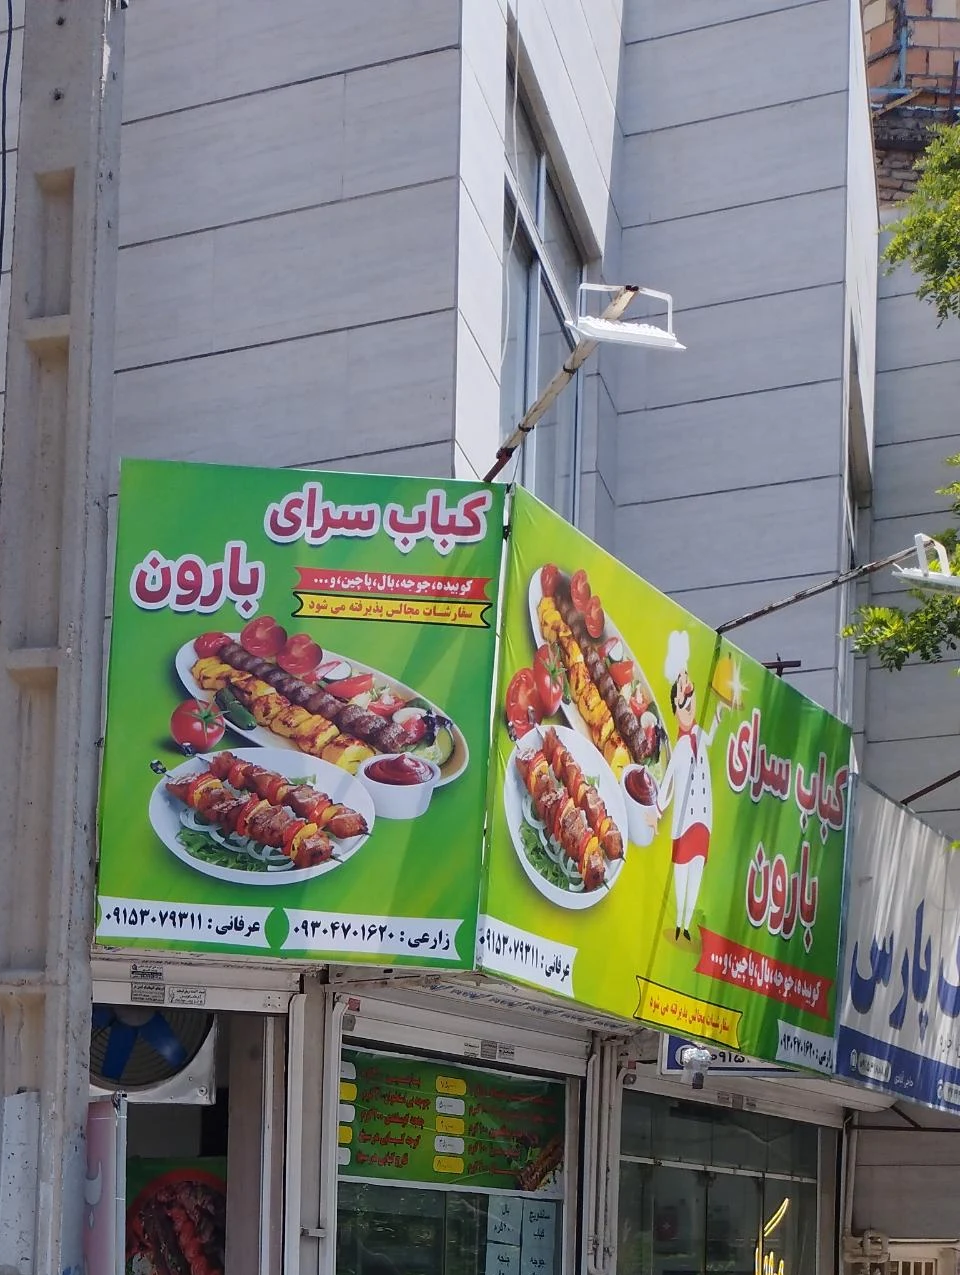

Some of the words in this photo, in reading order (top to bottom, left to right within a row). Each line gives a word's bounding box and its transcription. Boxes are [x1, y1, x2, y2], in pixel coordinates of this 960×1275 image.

[264, 482, 381, 545] سرای
[385, 488, 492, 555] کباب
[129, 540, 265, 619] بارون
[308, 600, 328, 613] شود
[330, 602, 346, 615] می
[349, 601, 384, 617] پذیرفته
[385, 603, 420, 618] مجالس
[727, 708, 791, 803] سرای
[795, 752, 849, 845] کباب
[105, 906, 203, 931] ۰۹۱۵۳۰۷۹۳۱۱
[745, 841, 819, 953] بارون
[293, 920, 395, 943] ۰۹۳۰۴۷۰۱۶۲۰
[478, 924, 540, 969] ۰۹۱۵۳۰۷۹۳۱۱
[851, 897, 932, 1044] پارس
